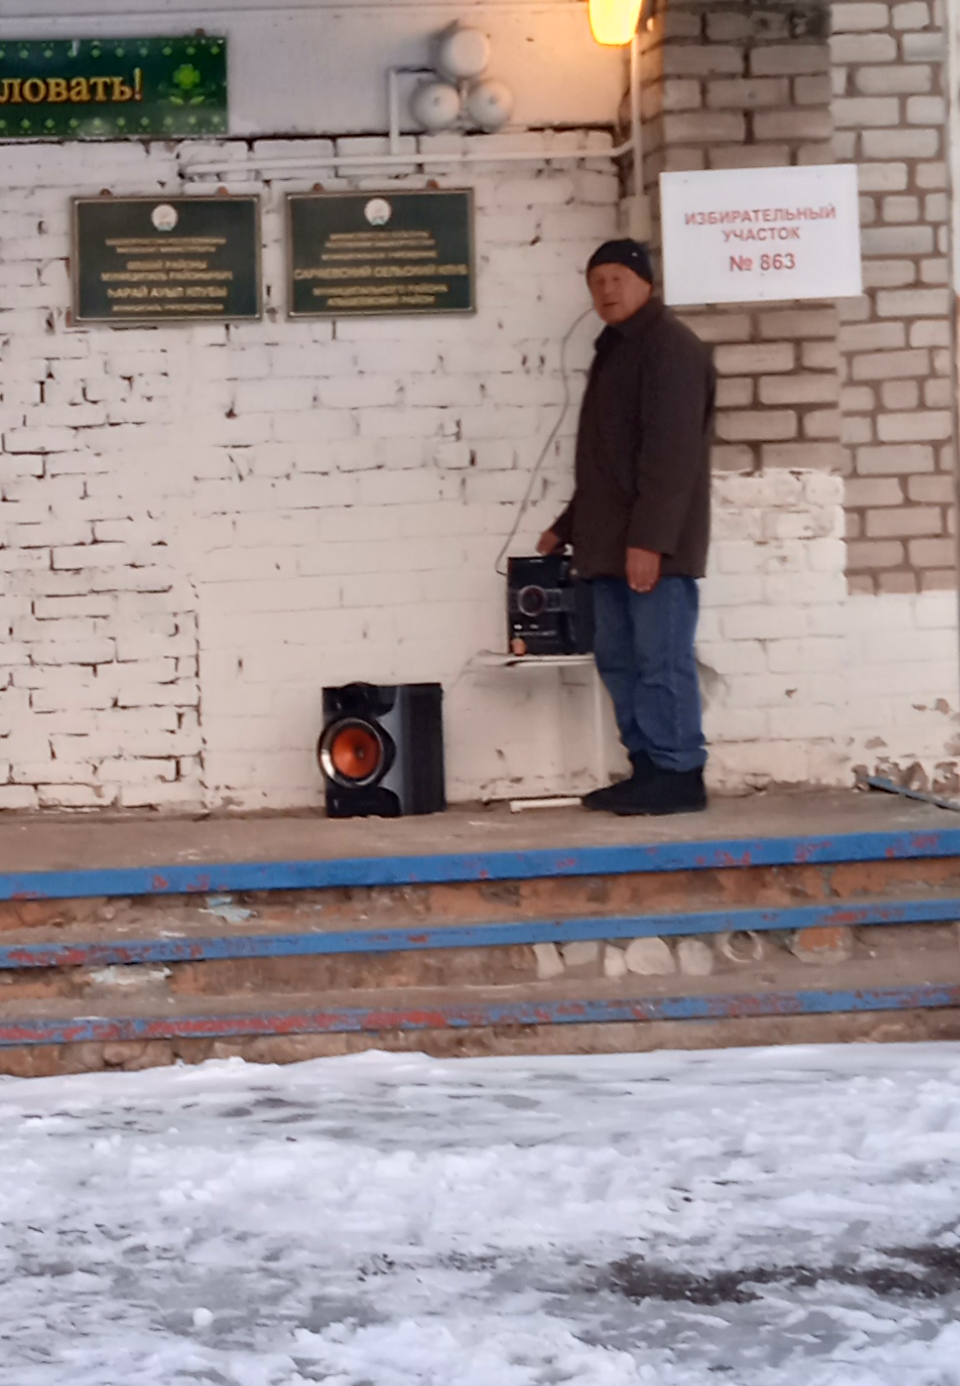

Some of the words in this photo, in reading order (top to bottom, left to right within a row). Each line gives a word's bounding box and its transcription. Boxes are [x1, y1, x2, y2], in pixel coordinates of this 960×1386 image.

[684, 205, 836, 225] ИЗБИРАТЕЛЬНЫЙ
[722, 226, 801, 243] УЧАСТОК
[729, 255, 754, 273] №
[759, 253, 797, 271] 863
